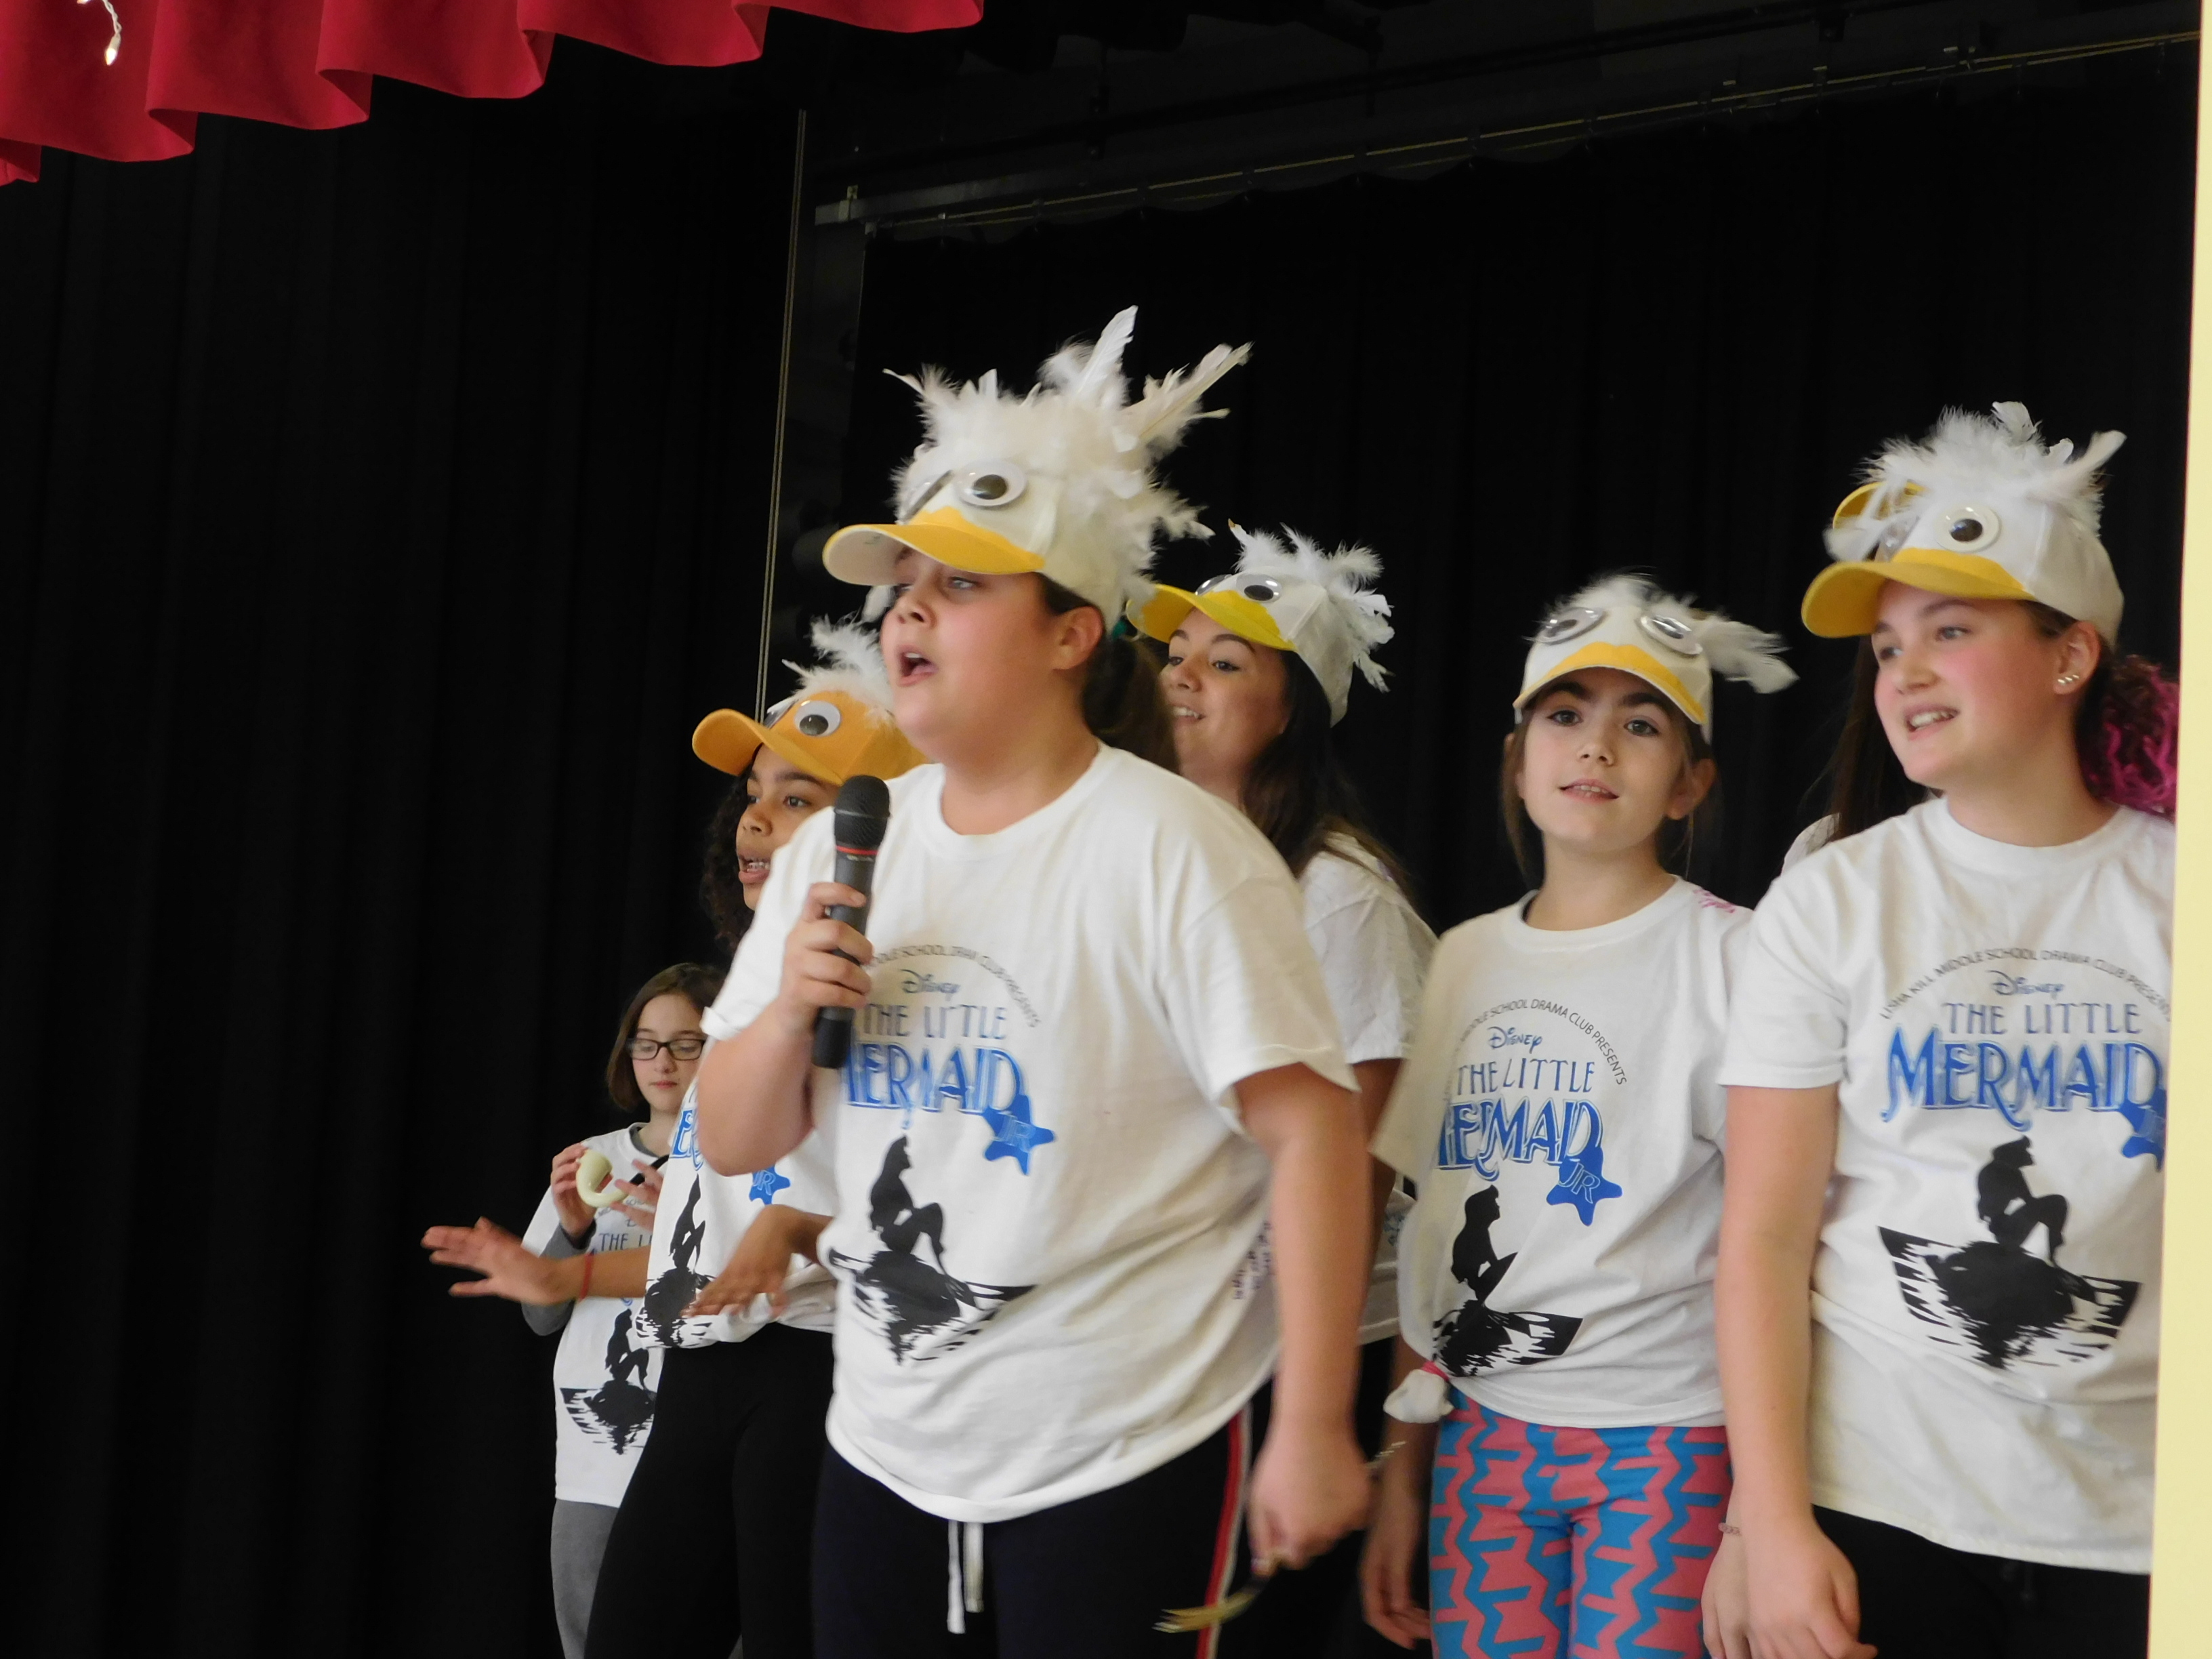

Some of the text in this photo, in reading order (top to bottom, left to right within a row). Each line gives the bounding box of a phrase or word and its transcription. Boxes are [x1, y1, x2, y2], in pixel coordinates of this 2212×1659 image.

[1933, 950, 1985, 977] MIDDLE
[1984, 947, 2038, 961] SCHOOL
[2041, 949, 2091, 963] DRAMA
[2092, 958, 2129, 979] CLUB
[863, 1003, 909, 1037] THE
[1940, 1002, 2144, 1036] THE LITTLE
[1490, 999, 1529, 1018] SCHOOL
[1530, 998, 1568, 1019] DRAMA
[1568, 1012, 1595, 1036] CLUB
[1591, 1030, 1627, 1086] PRESENTS
[1456, 1061, 1499, 1096] THE
[1502, 1057, 1596, 1093] LITTLE
[1879, 1024, 2165, 1132] MERMAID
[1558, 1162, 1601, 1204] JR
[599, 1233, 629, 1252] THE
